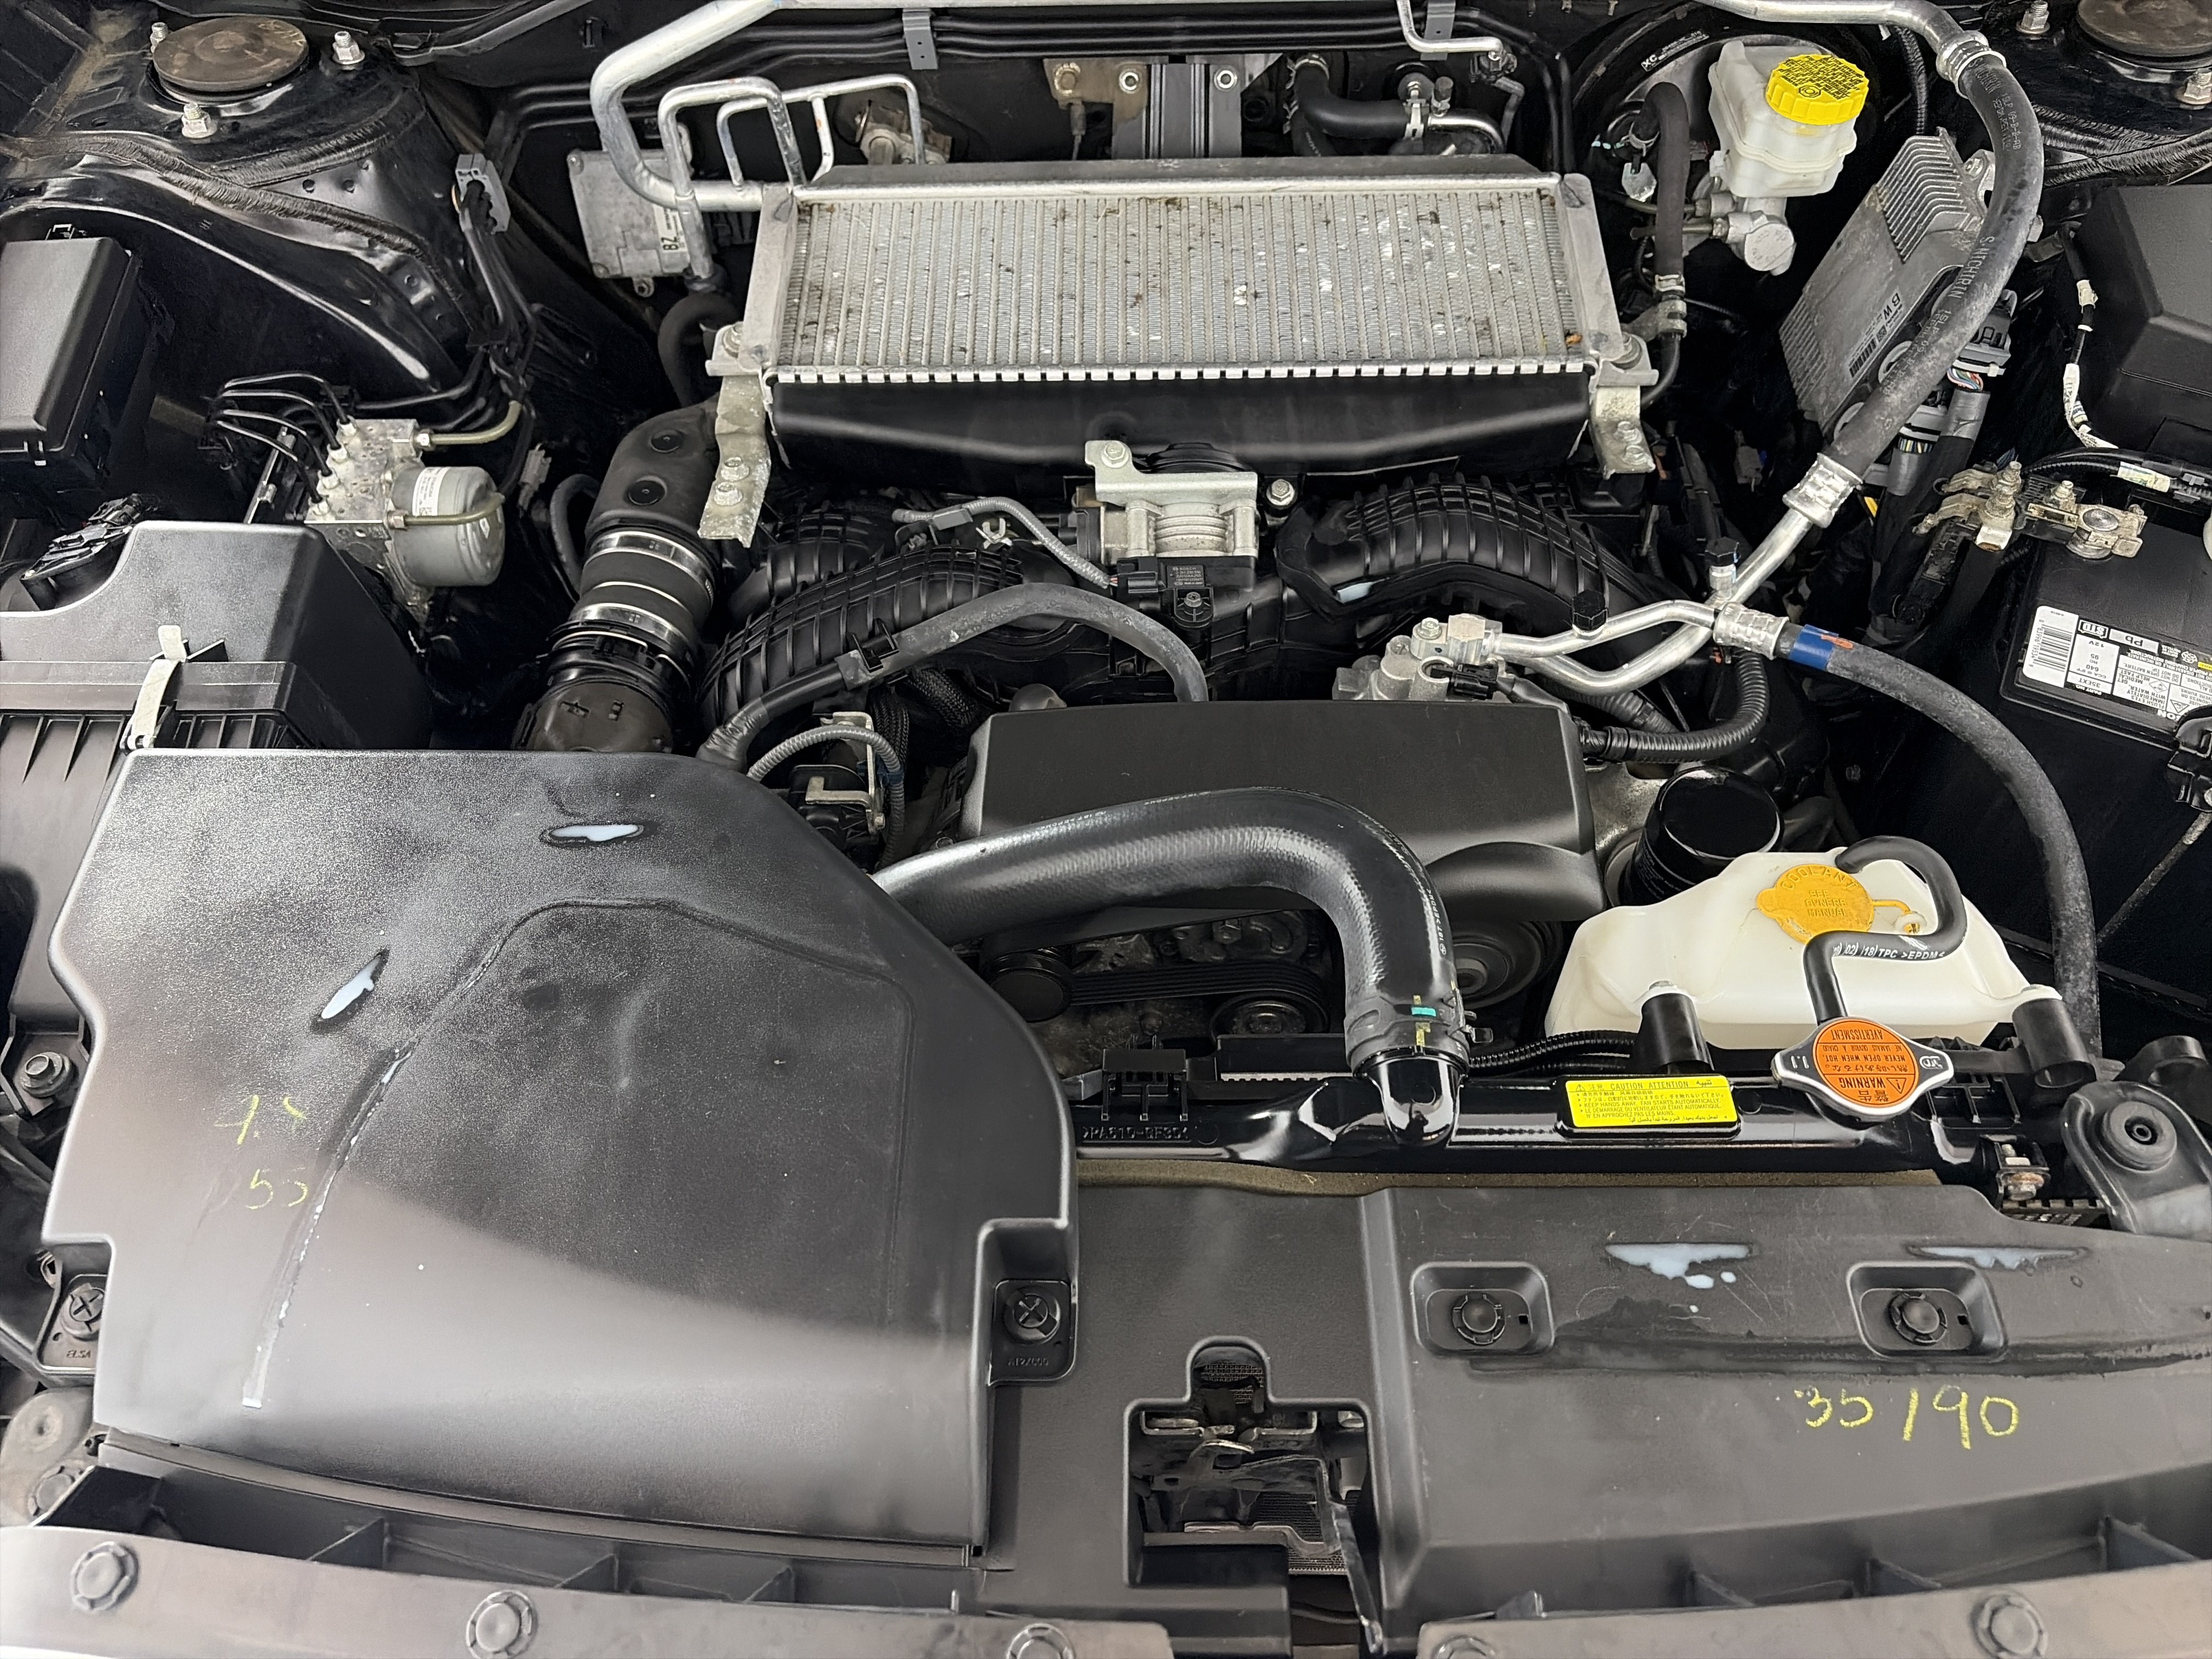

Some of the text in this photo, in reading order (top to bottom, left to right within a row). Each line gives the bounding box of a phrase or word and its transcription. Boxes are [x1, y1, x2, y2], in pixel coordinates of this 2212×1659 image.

[2125, 635, 2143, 647] Pb
[2079, 678, 2101, 688] 35EXT
[2118, 673, 2143, 684] MEDICAL
[2127, 690, 2165, 704] IMMEDIATELY
[2146, 699, 2164, 709] FLUSH
[1782, 865, 1859, 890] COOLANT
[1809, 890, 1830, 899] SEE
[1808, 909, 1848, 918] MANUAL
[1878, 949, 1898, 958] TPC
[1900, 950, 1945, 960] >EPDM<
[1610, 1081, 1689, 1091] CAUTION ATTENTION
[1839, 1077, 1886, 1088] WARNING
